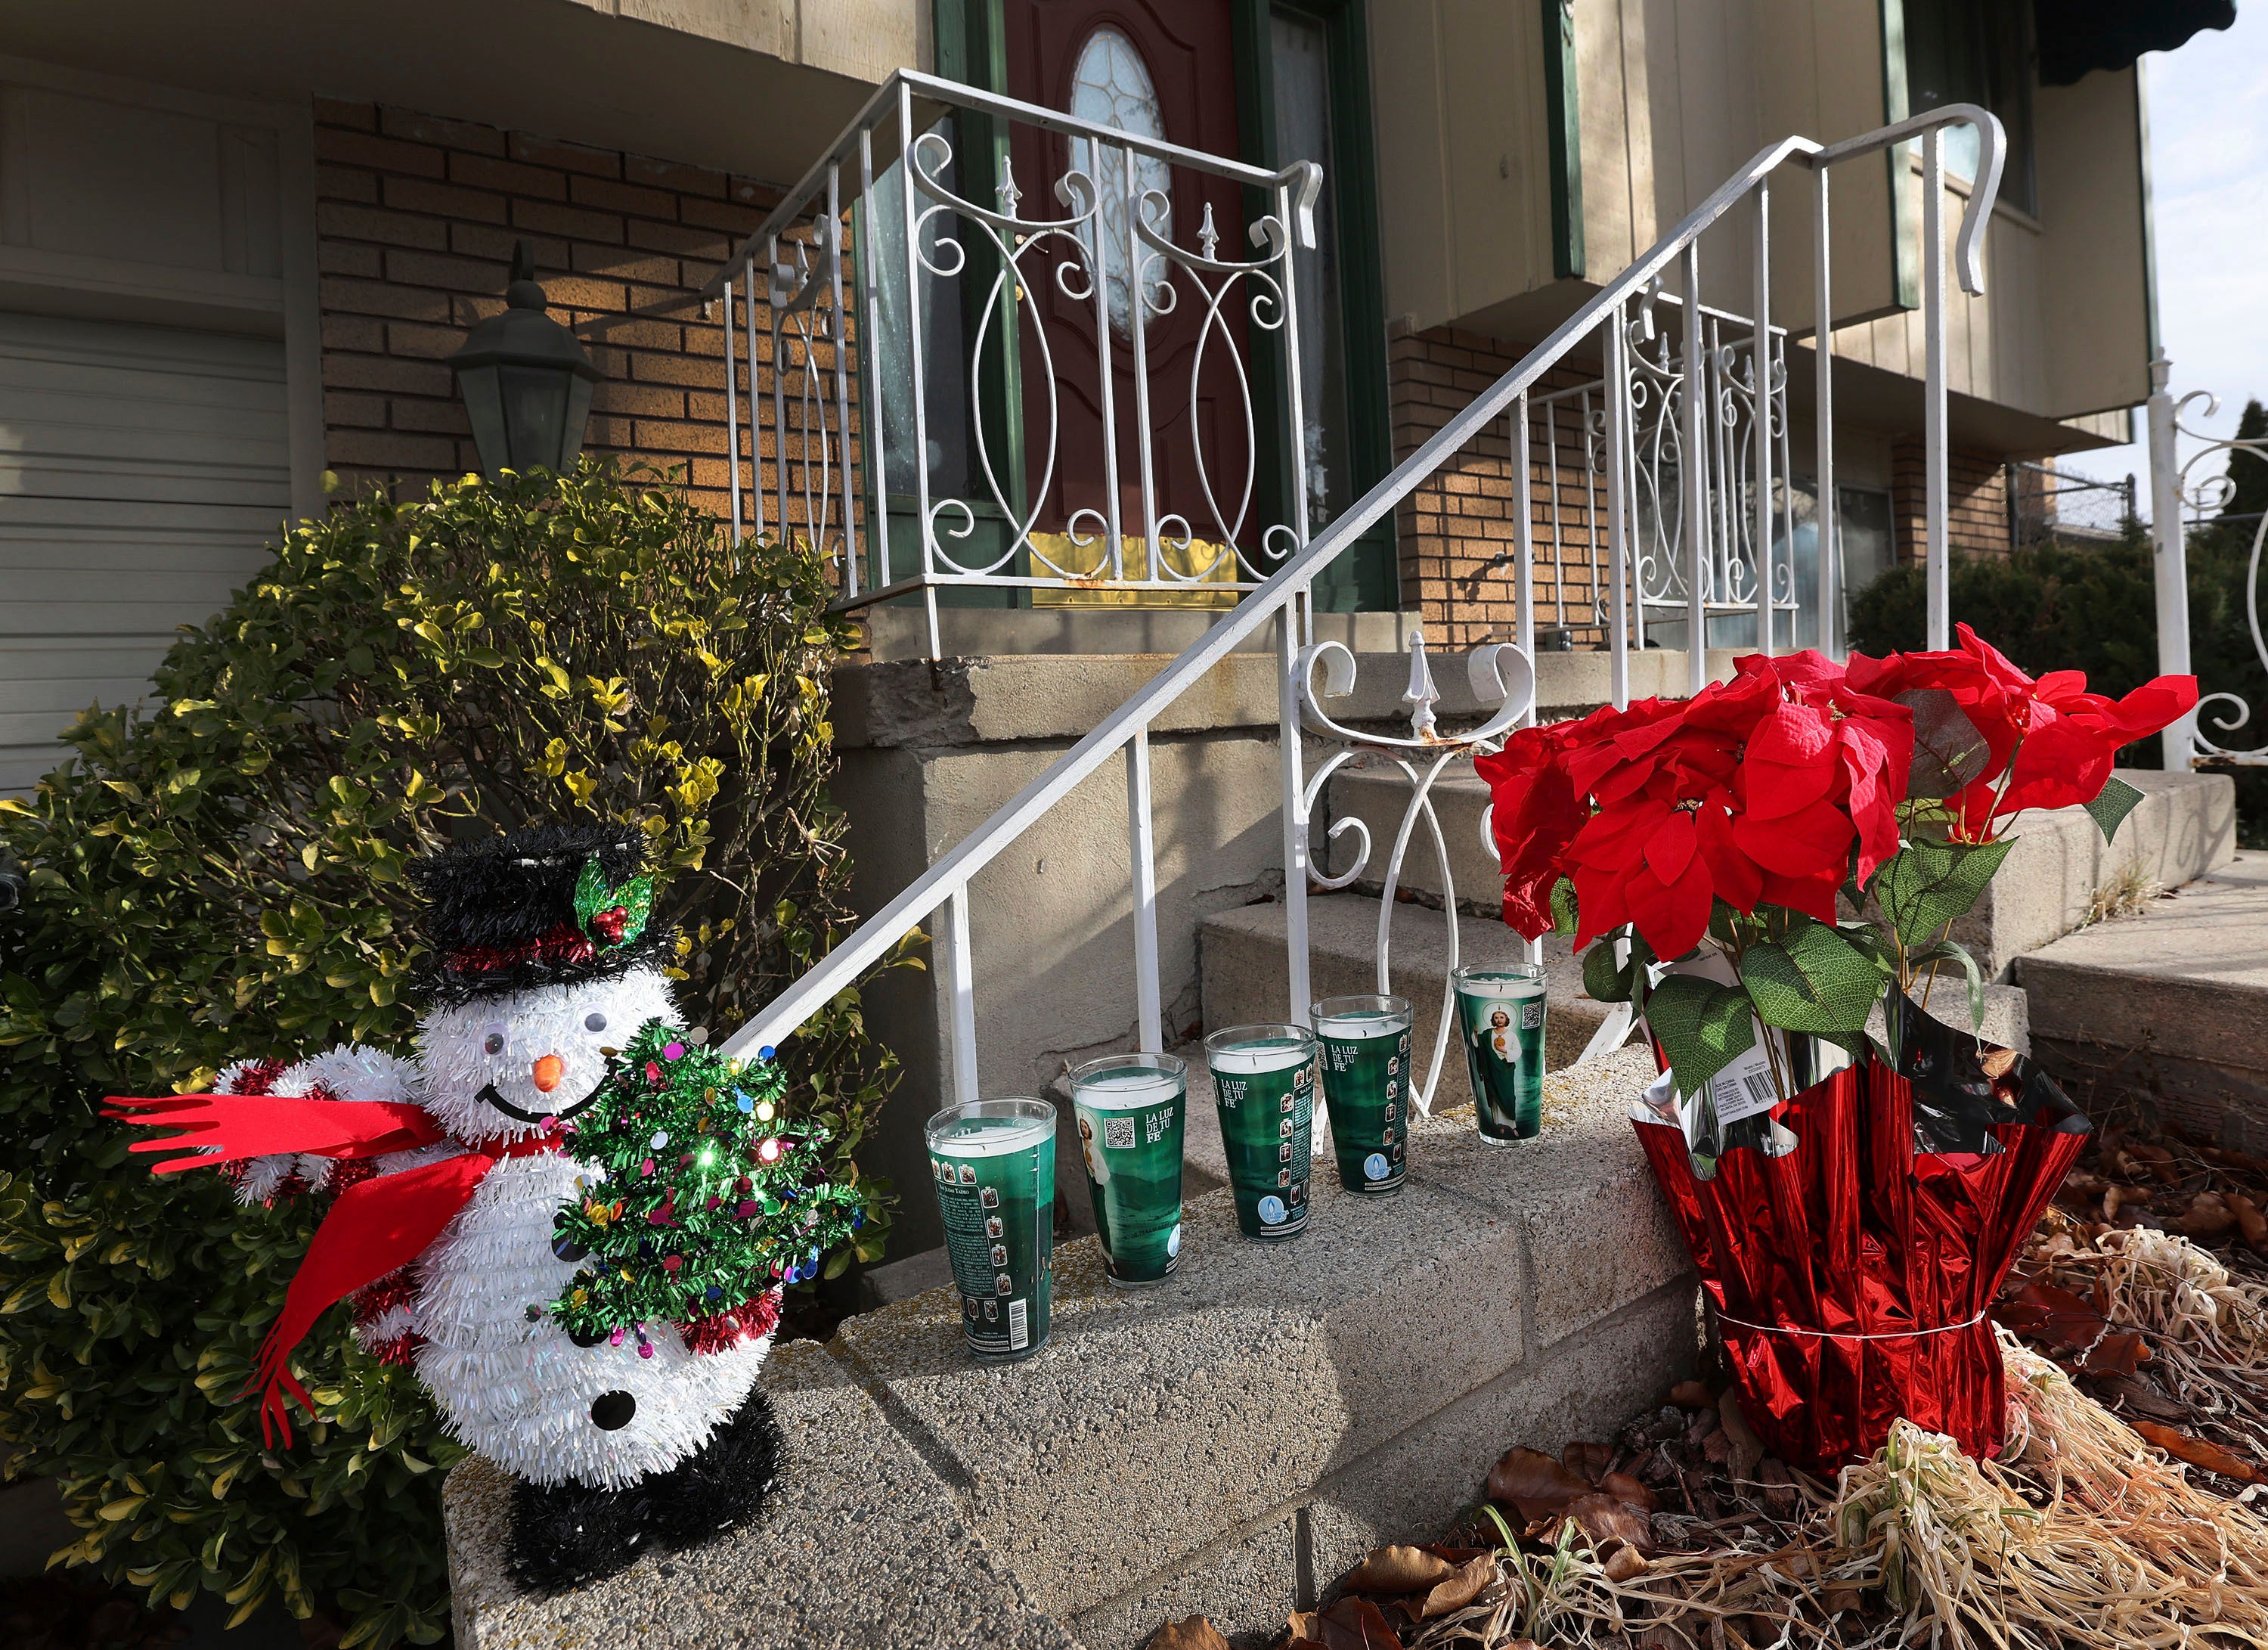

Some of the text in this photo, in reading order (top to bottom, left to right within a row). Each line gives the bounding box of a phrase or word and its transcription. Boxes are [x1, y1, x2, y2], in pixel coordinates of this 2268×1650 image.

[1331, 1044, 1359, 1055] LA LUZ
[1332, 1053, 1355, 1063] DE TU
[1221, 1078, 1247, 1090] LA LUZ
[1222, 1088, 1244, 1100] DE TU
[1146, 1107, 1173, 1124] LA LUZ
[1146, 1118, 1170, 1134] DE TU
